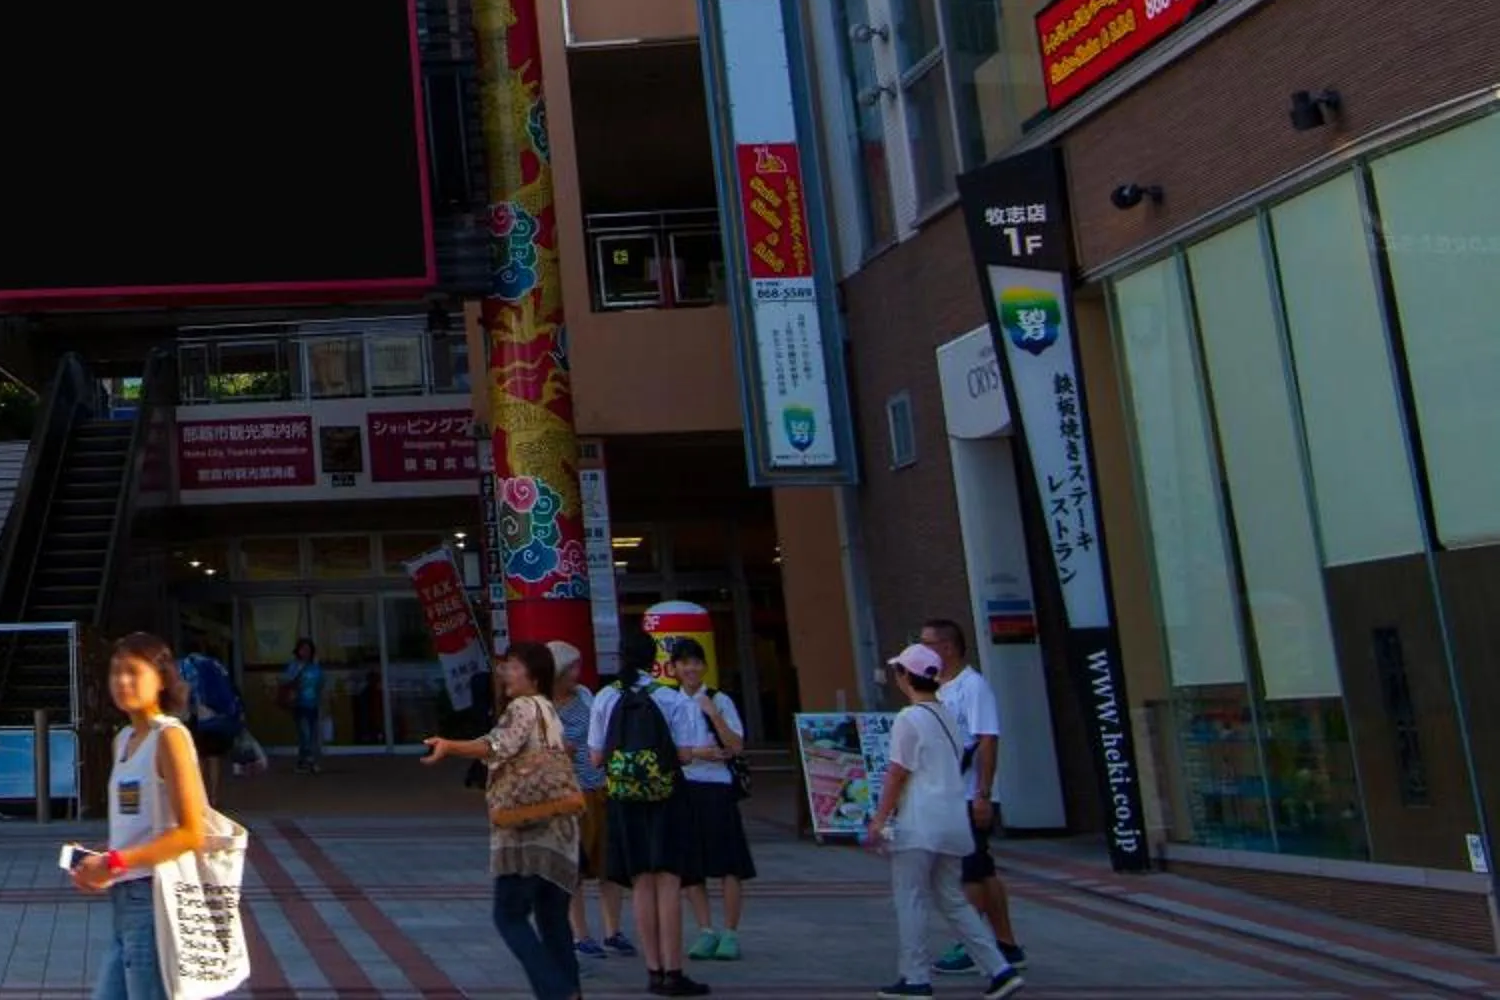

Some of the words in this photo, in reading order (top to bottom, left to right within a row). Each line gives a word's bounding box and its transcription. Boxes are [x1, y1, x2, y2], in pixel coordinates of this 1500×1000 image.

[985, 203, 1047, 227] 牧志店
[1003, 228, 1043, 256] 1F
[1047, 474, 1078, 586] レストラン
[1086, 648, 1141, 854] www.heki.co.jp
